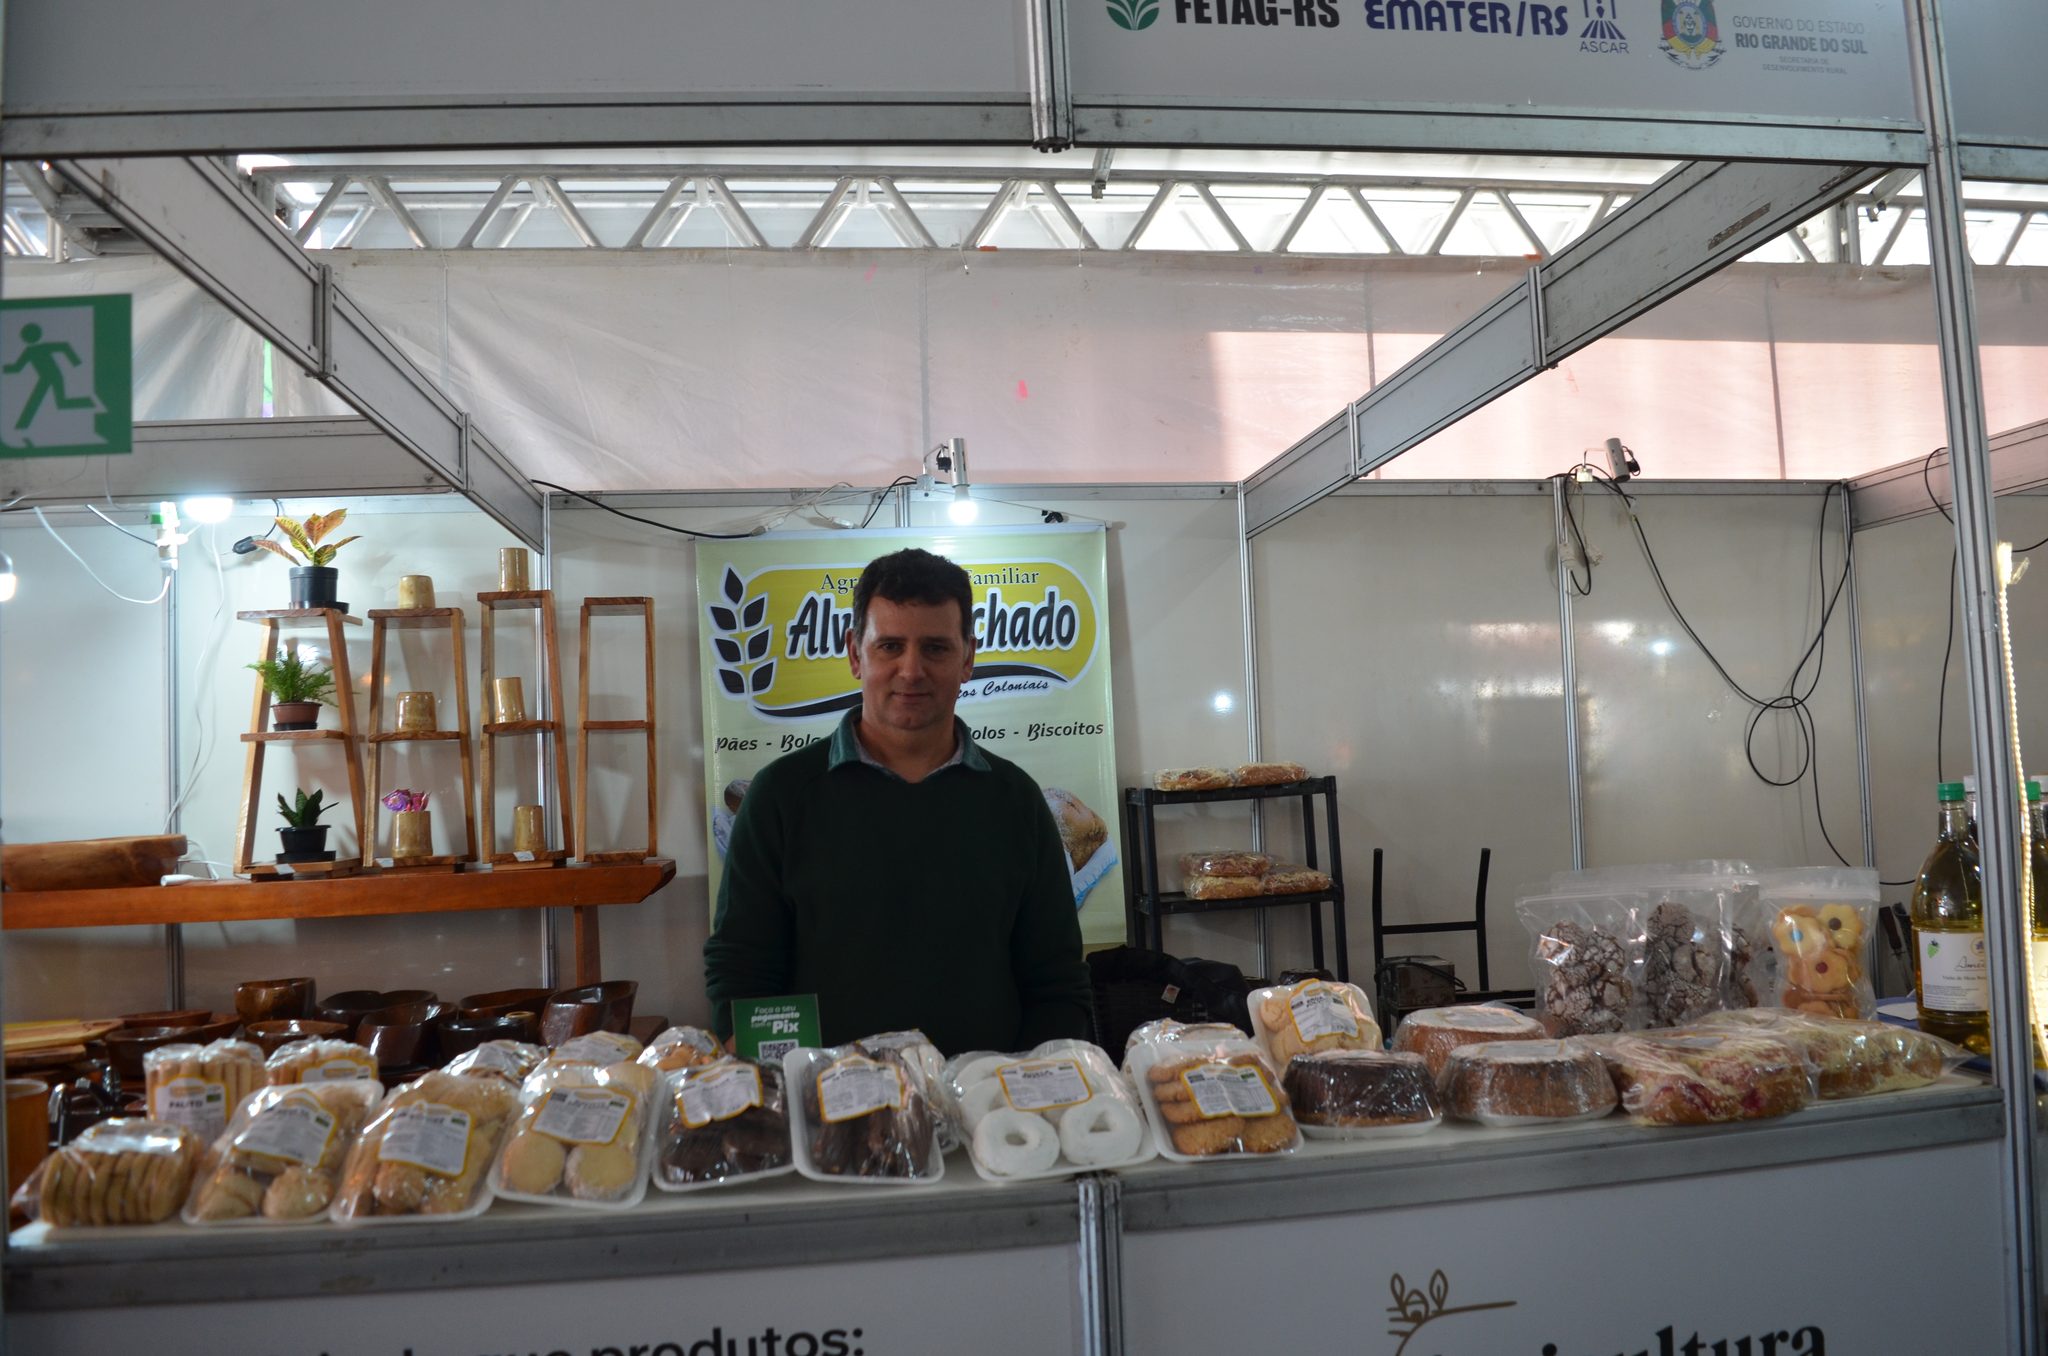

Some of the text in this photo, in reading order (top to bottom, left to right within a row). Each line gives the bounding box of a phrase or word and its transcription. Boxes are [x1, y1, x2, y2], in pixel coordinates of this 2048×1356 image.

[1174, 0, 1340, 28] FETAG-RS
[1364, 0, 1569, 37] EMATER/RS
[1732, 15, 1865, 35] GOVERNO DO ESTADO
[1579, 40, 1630, 54] ASCAR
[1735, 33, 1869, 54] RIO GRANDE DO SUL
[821, 574, 858, 595] Agr
[788, 590, 1076, 656] Alv chado
[983, 680, 1050, 697] Coloniais
[970, 726, 1006, 740] olos
[1026, 721, 1104, 741] Biscoitos
[715, 737, 758, 754] Pães
[780, 733, 821, 753] Bol
[751, 1012, 800, 1024] pagamento
[782, 1005, 797, 1013] seu
[772, 1020, 799, 1035] Pix
